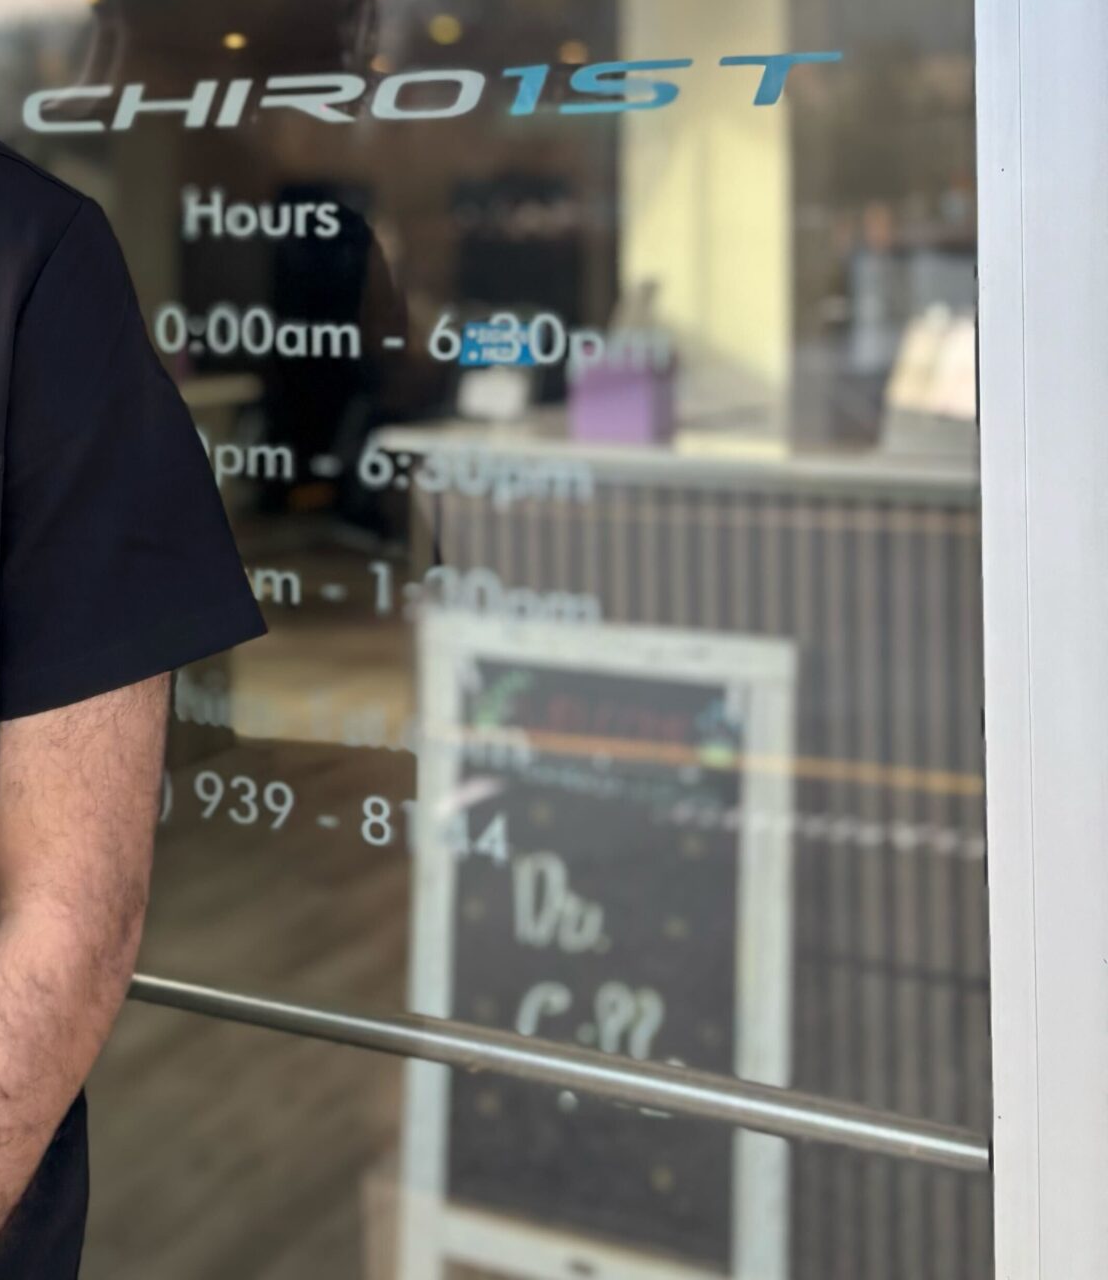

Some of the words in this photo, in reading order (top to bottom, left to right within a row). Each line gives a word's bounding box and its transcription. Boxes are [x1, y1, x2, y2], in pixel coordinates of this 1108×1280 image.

[22, 51, 844, 133] CHIRO1ST
[182, 187, 342, 240] Hours
[196, 427, 296, 487] pm
[193, 770, 297, 832] 939
